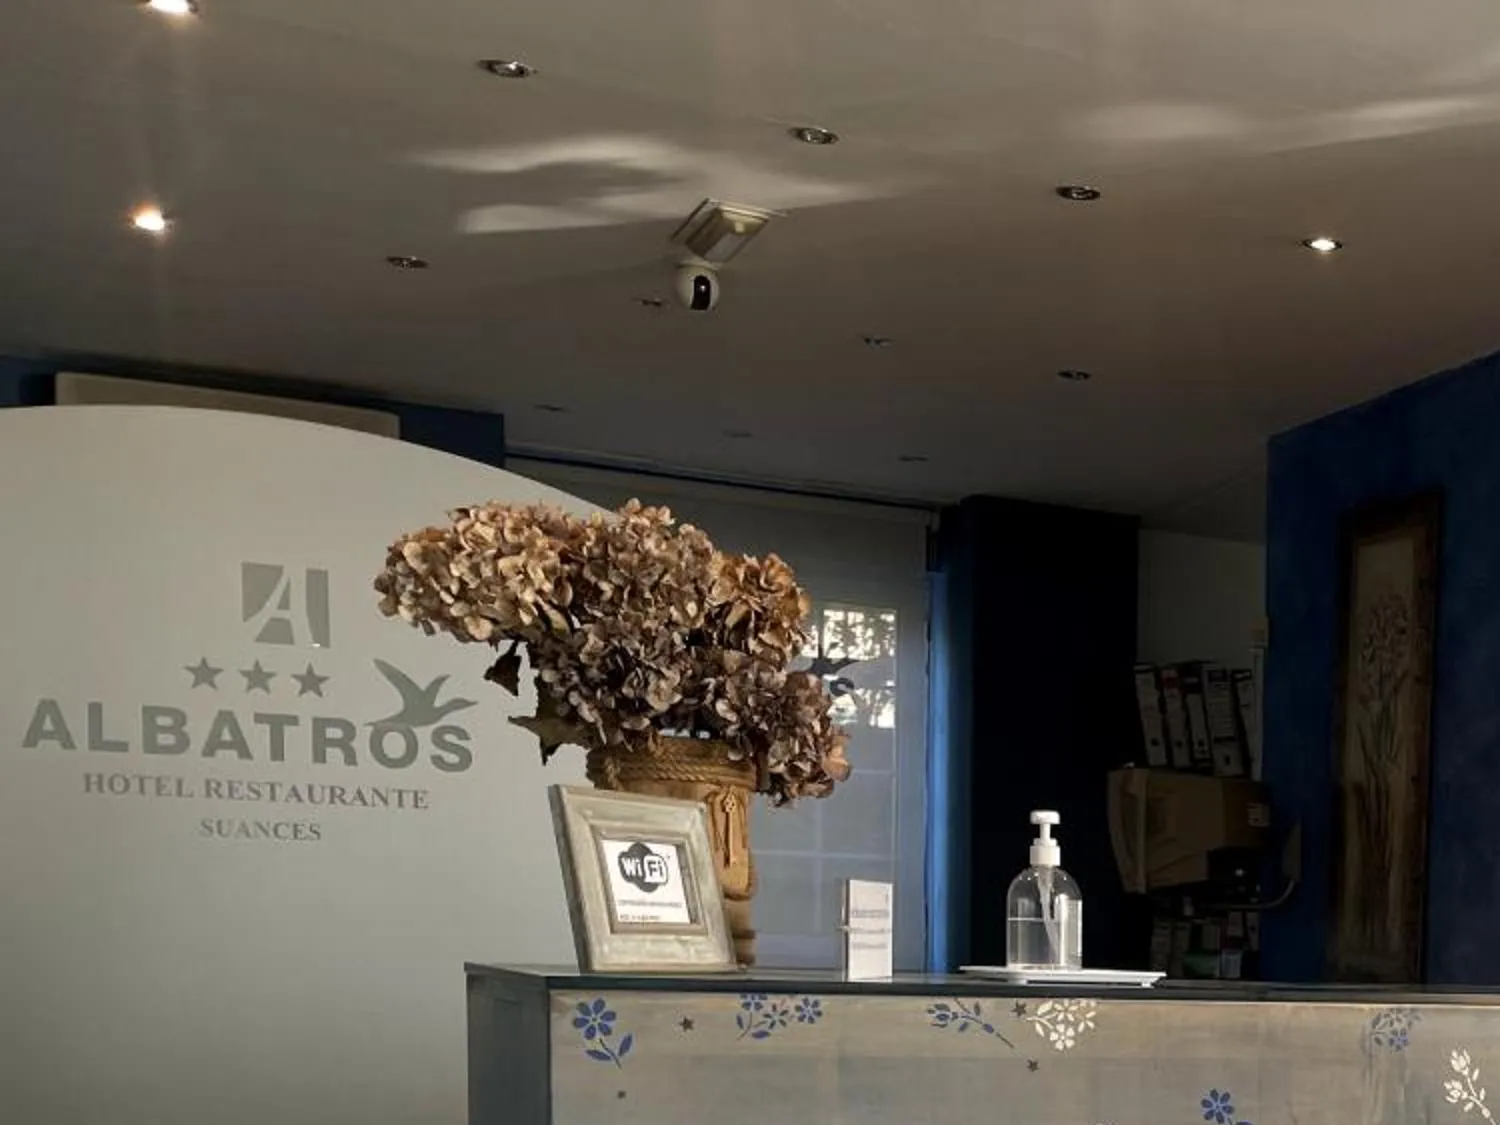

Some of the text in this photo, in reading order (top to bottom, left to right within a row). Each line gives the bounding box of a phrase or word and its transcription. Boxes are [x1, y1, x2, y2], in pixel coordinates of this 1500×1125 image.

[22, 698, 473, 773] ALBATROS
[83, 772, 429, 810] HOTEL RESTAURANTE
[199, 817, 322, 842] SUANCES
